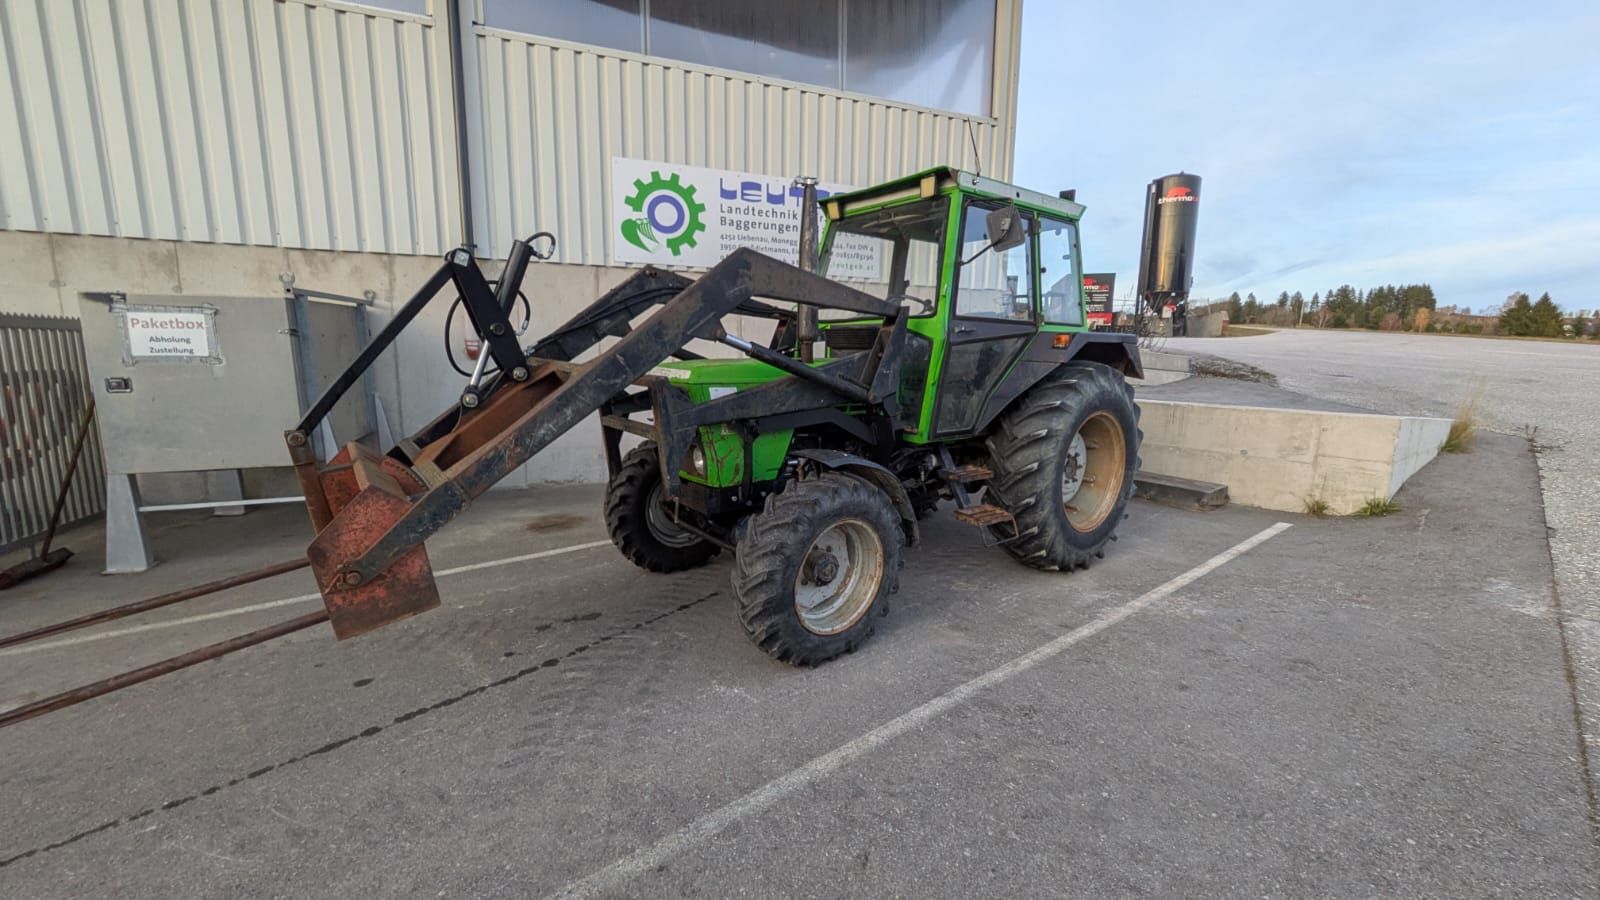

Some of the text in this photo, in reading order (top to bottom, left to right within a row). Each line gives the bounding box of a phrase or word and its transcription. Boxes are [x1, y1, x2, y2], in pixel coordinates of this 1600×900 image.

[720, 203, 798, 220] Landtechnik
[720, 216, 798, 234] Baggerungen
[130, 317, 205, 329] Paketbox
[149, 336, 191, 344] Abholung
